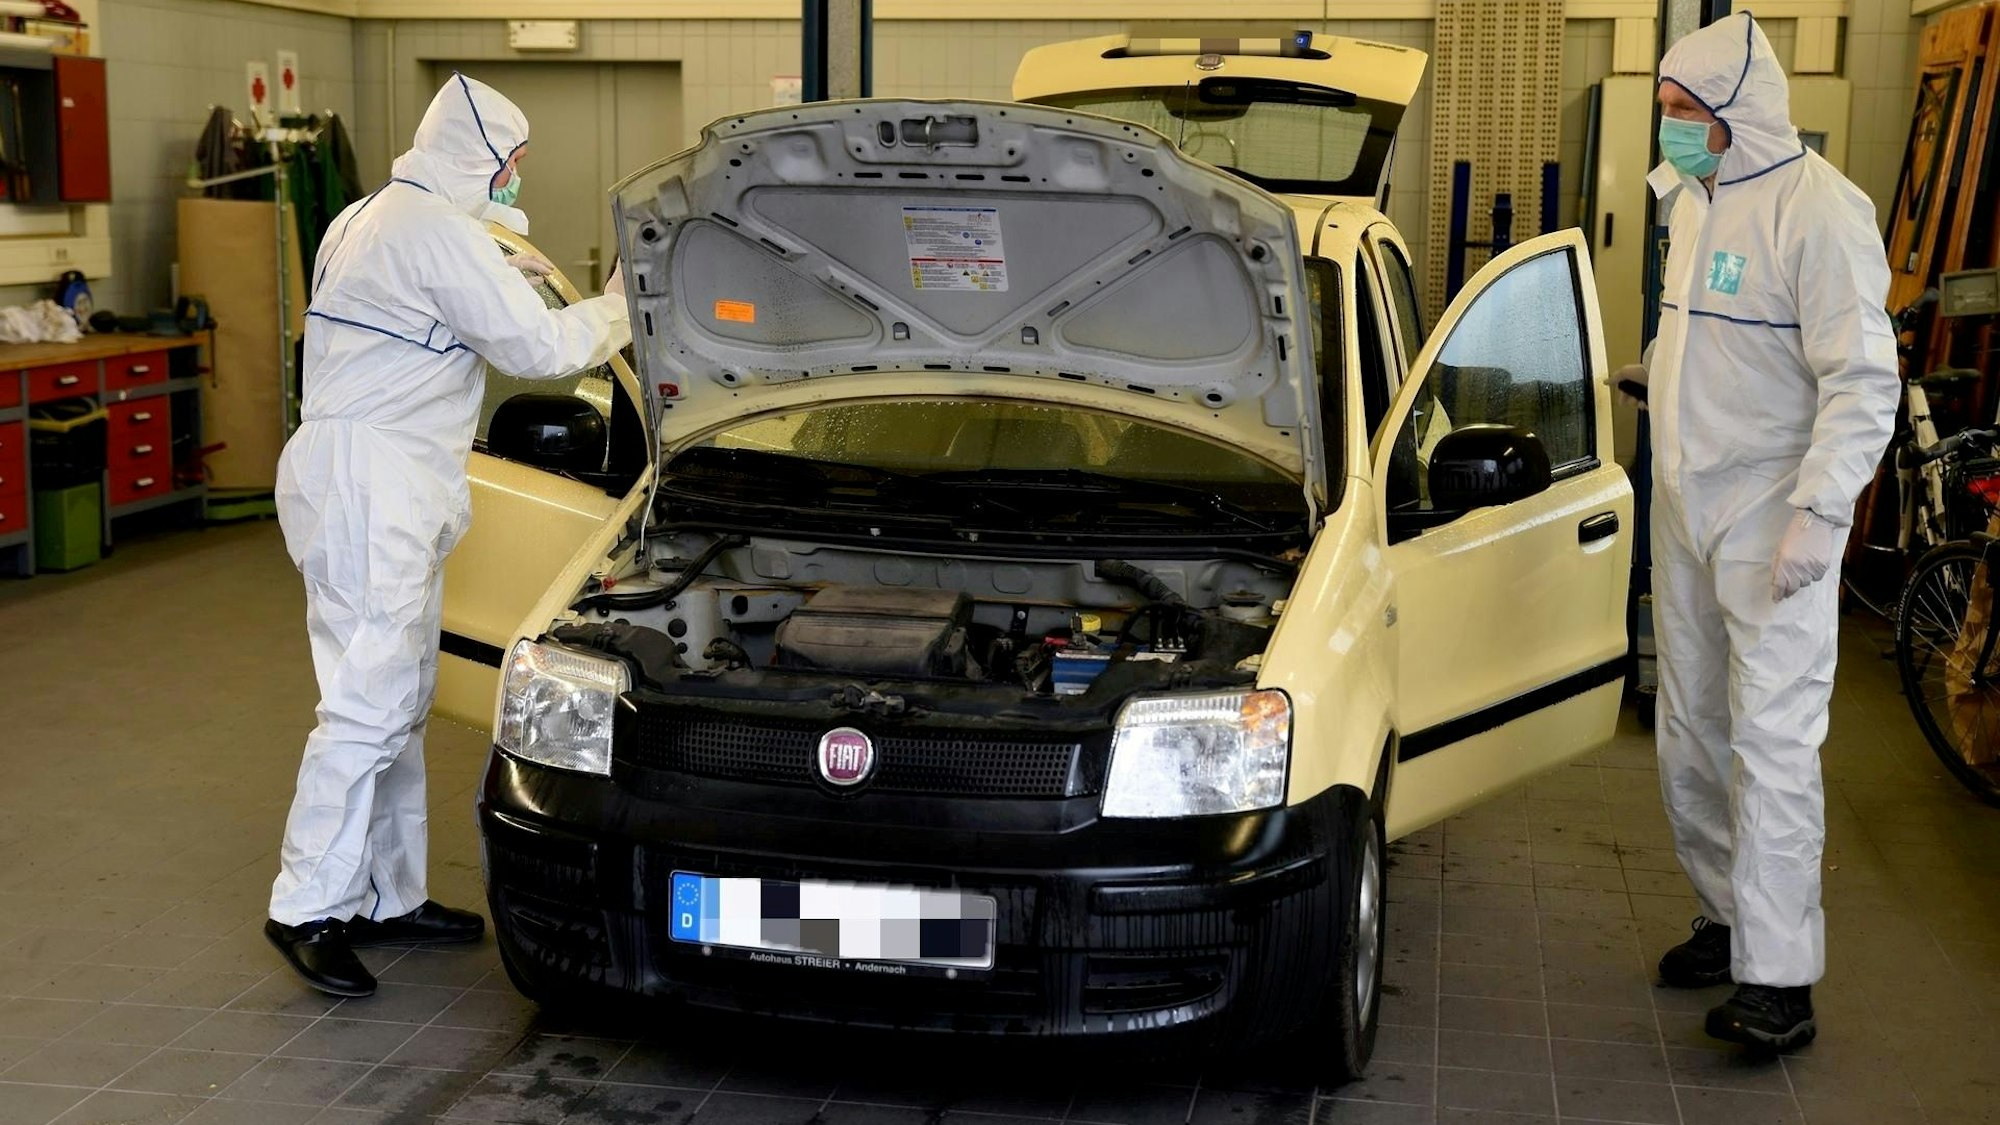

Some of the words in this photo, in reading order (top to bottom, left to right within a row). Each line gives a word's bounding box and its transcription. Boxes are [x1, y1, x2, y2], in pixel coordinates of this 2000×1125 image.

[829, 743, 863, 771] FIAT
[682, 912, 692, 928] D
[750, 952, 792, 965] Autohaus
[795, 956, 840, 969] STREIER
[855, 962, 906, 974] Andernach
